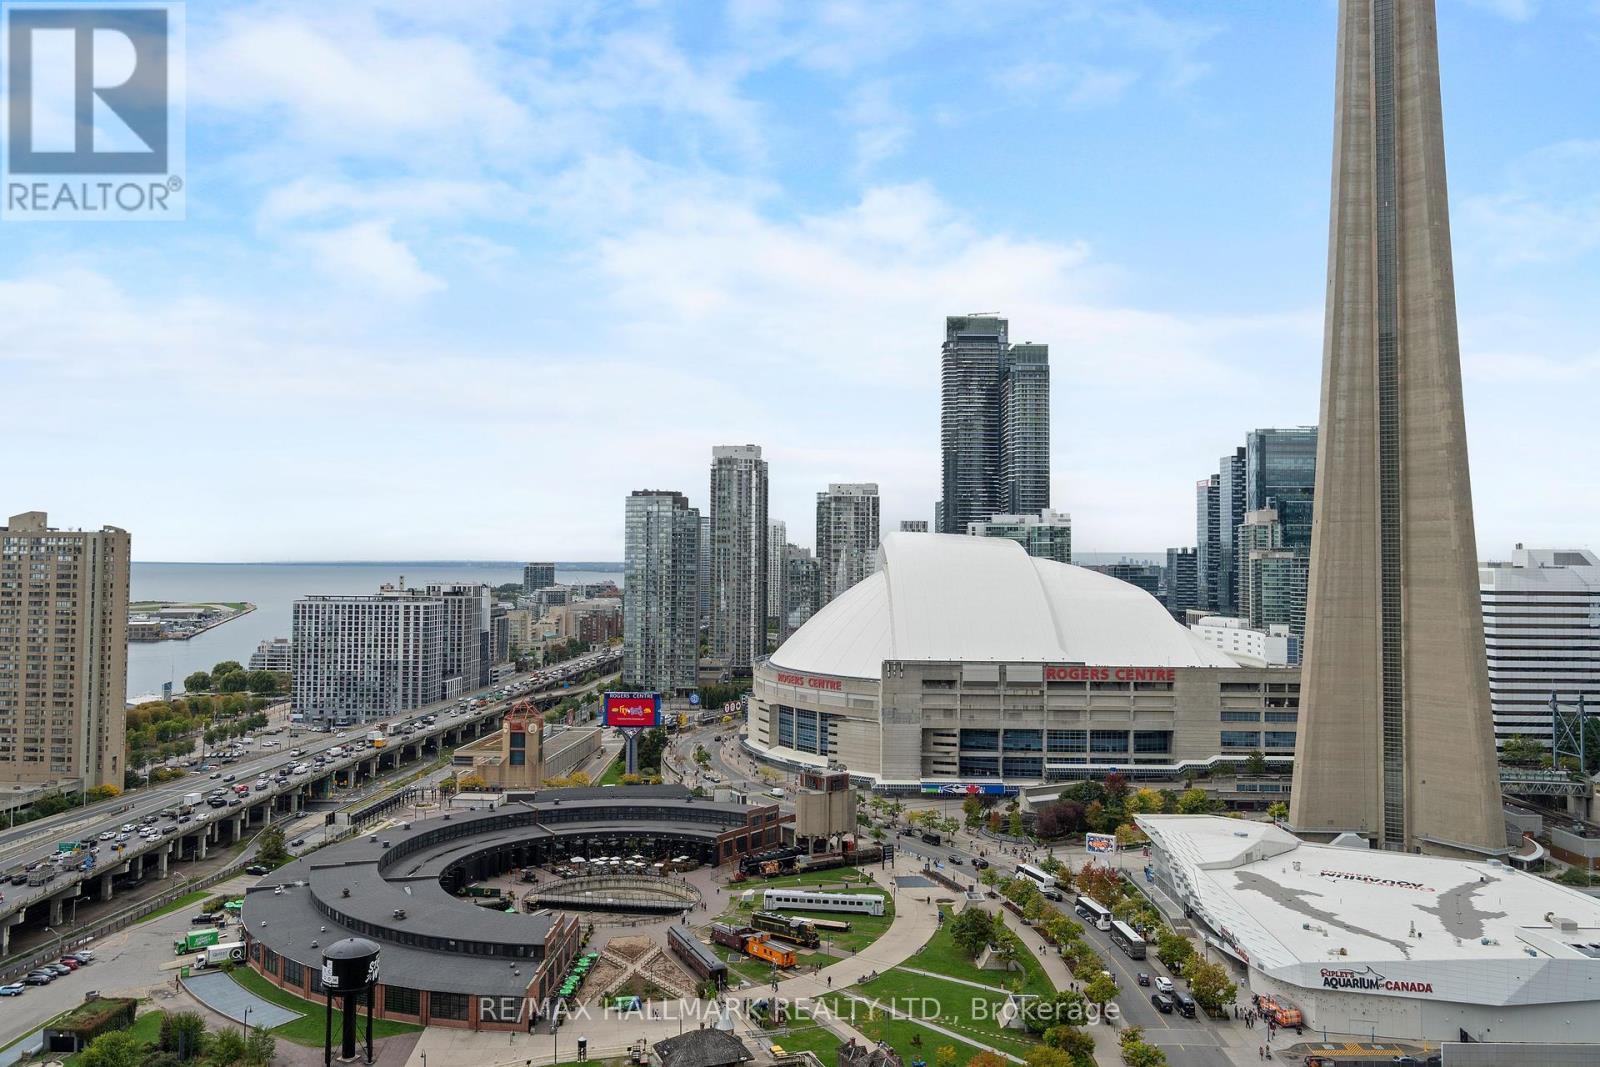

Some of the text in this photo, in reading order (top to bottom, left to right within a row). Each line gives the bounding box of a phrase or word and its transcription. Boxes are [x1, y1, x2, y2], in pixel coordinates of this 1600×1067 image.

[777, 672, 842, 691] ROGERS CENTRE
[1046, 667, 1175, 681] ROGERS CENTRE
[1323, 977, 1379, 990] AQUARIUM
[1385, 980, 1433, 993] CANADA
